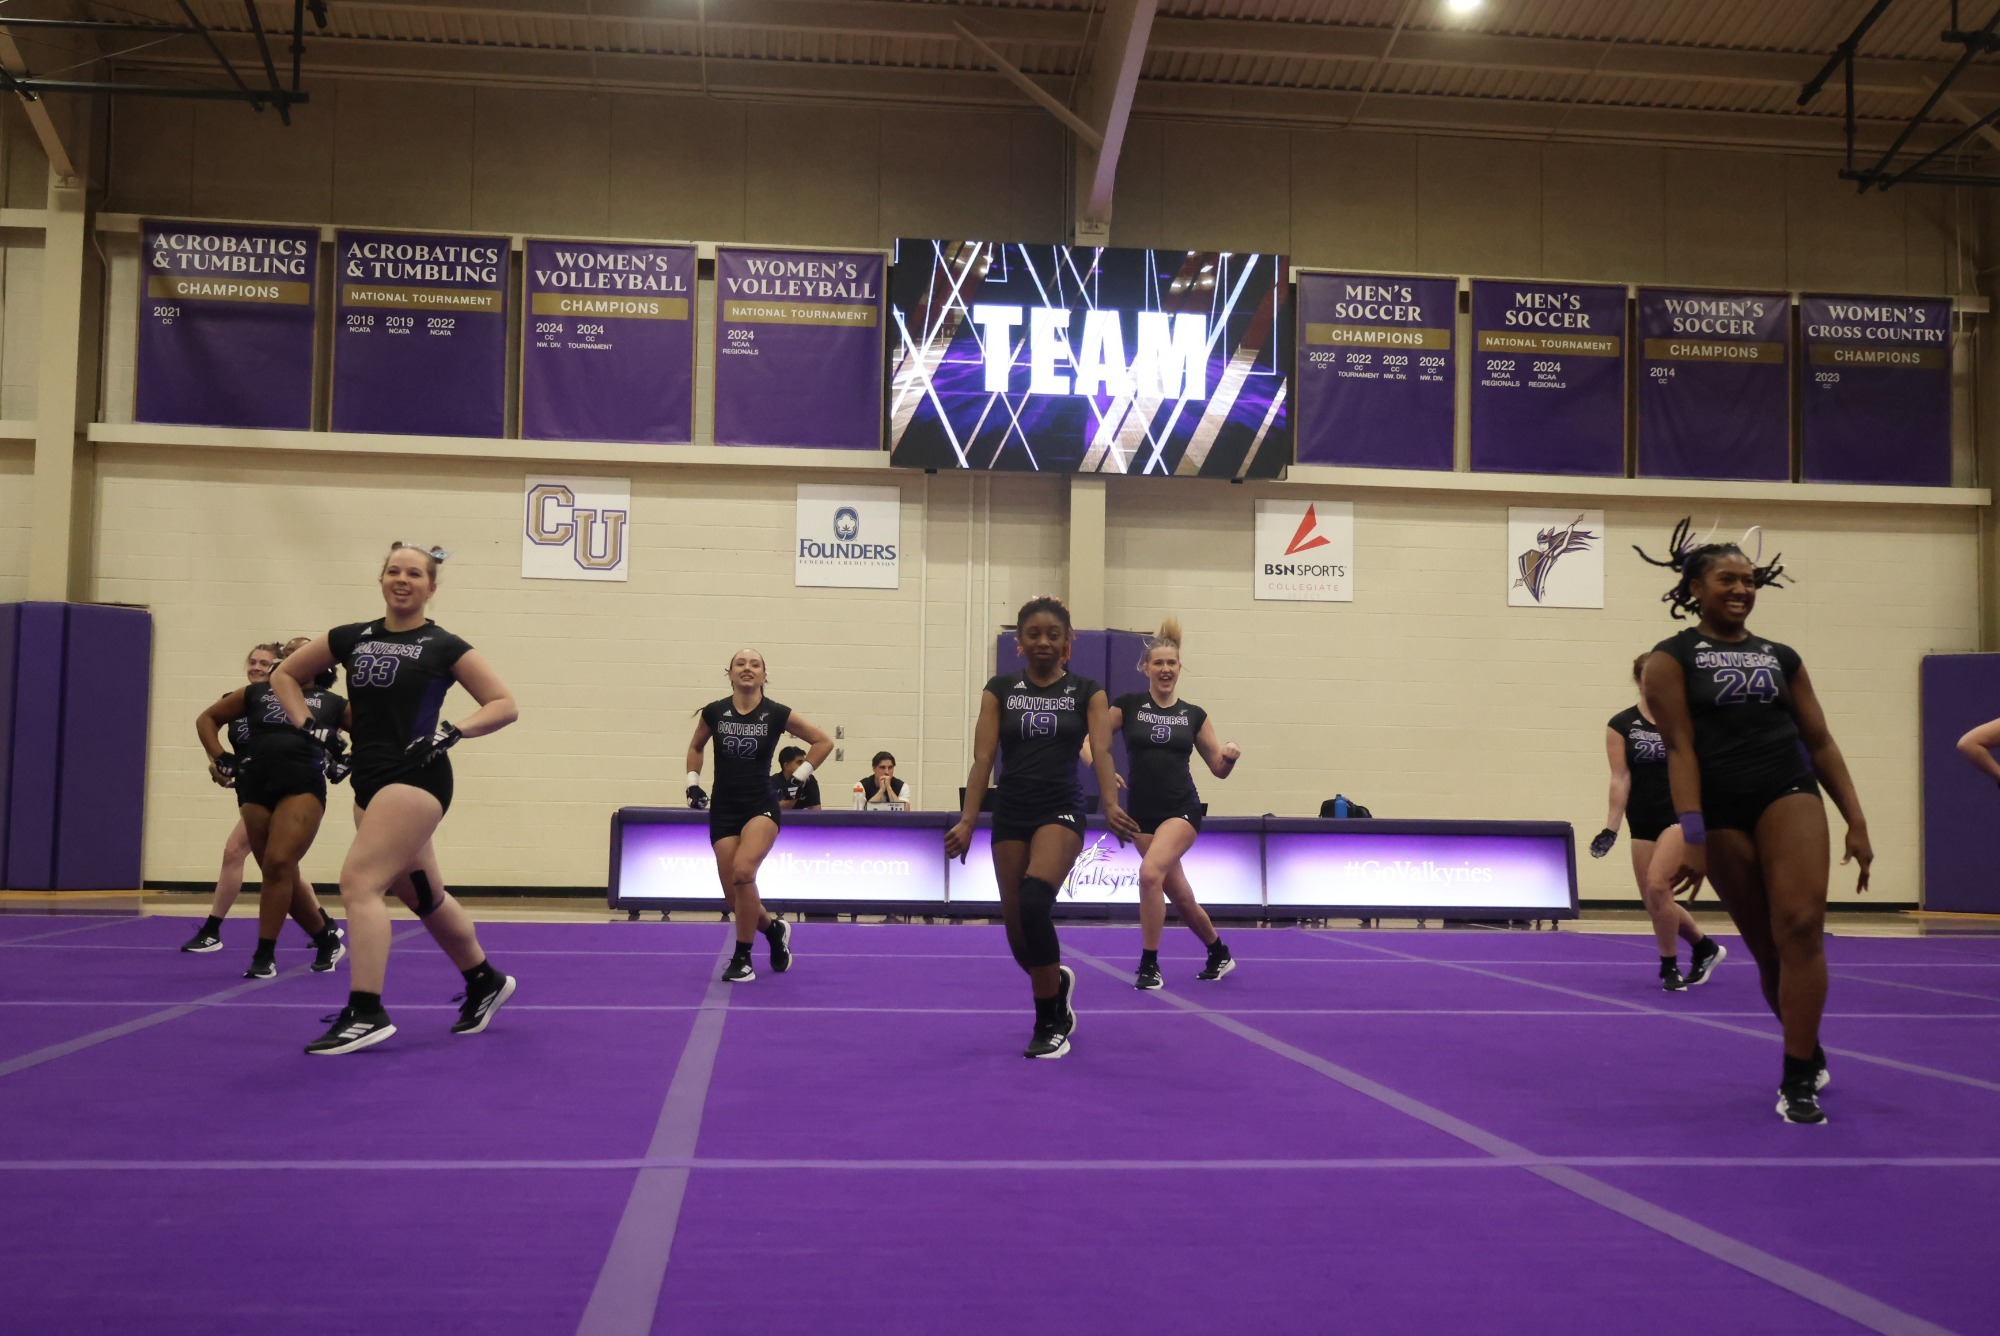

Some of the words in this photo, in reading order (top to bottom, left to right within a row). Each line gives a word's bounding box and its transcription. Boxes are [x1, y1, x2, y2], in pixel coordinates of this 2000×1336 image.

[153, 233, 307, 256] ACROBATICS
[347, 242, 498, 264] ACROBATICS
[152, 251, 171, 269] &
[176, 253, 306, 275] TUMBLING
[555, 252, 668, 272] WOMEN'S
[747, 259, 857, 280] WOMEN'S
[346, 260, 365, 278] &
[370, 262, 497, 284] TUMBLING
[536, 270, 687, 293] VOLLEYBALL
[727, 278, 876, 299] VOLLEYBALL
[177, 282, 280, 299] CHAMPIONS
[351, 291, 408, 303] NATIONAL
[412, 294, 492, 306] TOURNAMENT
[1345, 285, 1412, 303] MEN'S
[560, 299, 659, 315] CHAMPIONS
[1515, 292, 1581, 310] MEN'S
[1665, 299, 1764, 318] WOMEN'S
[153, 306, 180, 318] 2021
[732, 307, 787, 318] NATIONAL
[791, 309, 868, 321] TOURNAMENT
[1335, 303, 1422, 322] SOCCER
[1505, 310, 1591, 329] SOCCER
[1828, 305, 1926, 323] WOMEN'S
[346, 315, 375, 327] 2018
[385, 316, 414, 328] 2019
[427, 317, 455, 329] 2022
[536, 323, 563, 334] 2024
[577, 324, 604, 335] 2024
[1673, 318, 1756, 335] SOCCER
[727, 330, 754, 340] 2024
[1332, 330, 1424, 345] CHAMPIONS
[1808, 324, 1862, 339] CROSS
[1866, 327, 1946, 342] COUNTRY
[973, 304, 1208, 401] TEAM
[1486, 337, 1538, 348] NATIONAL
[1541, 339, 1613, 351] TOURNAMENT
[1670, 344, 1759, 359] CHAMPIONS
[1310, 352, 1335, 363] 2022
[1346, 353, 1372, 364] 2022
[1383, 355, 1408, 366] 2023
[1419, 356, 1445, 367] 2024
[1487, 359, 1515, 371] 2022
[1533, 361, 1561, 372] 2024
[1834, 350, 1920, 364] CHAMPIONS
[1338, 371, 1380, 379] TOURNAMENT
[1650, 367, 1675, 377] 2014
[1815, 372, 1840, 383] 2023
[799, 538, 897, 560] FOUNDERS
[1264, 564, 1295, 576] BSN
[1297, 564, 1345, 577] SPORTS
[1268, 583, 1340, 592] COLLEGIATE
[352, 655, 400, 688] 33
[1713, 668, 1779, 706] 24
[1007, 694, 1075, 711] CONVERSE
[1021, 712, 1057, 740] 19
[1137, 710, 1189, 726] CONVERSE
[717, 721, 768, 736] CONVERSE
[1150, 725, 1172, 743] 3
[723, 736, 757, 760] 32
[1344, 860, 1493, 886] #GoValkyries
